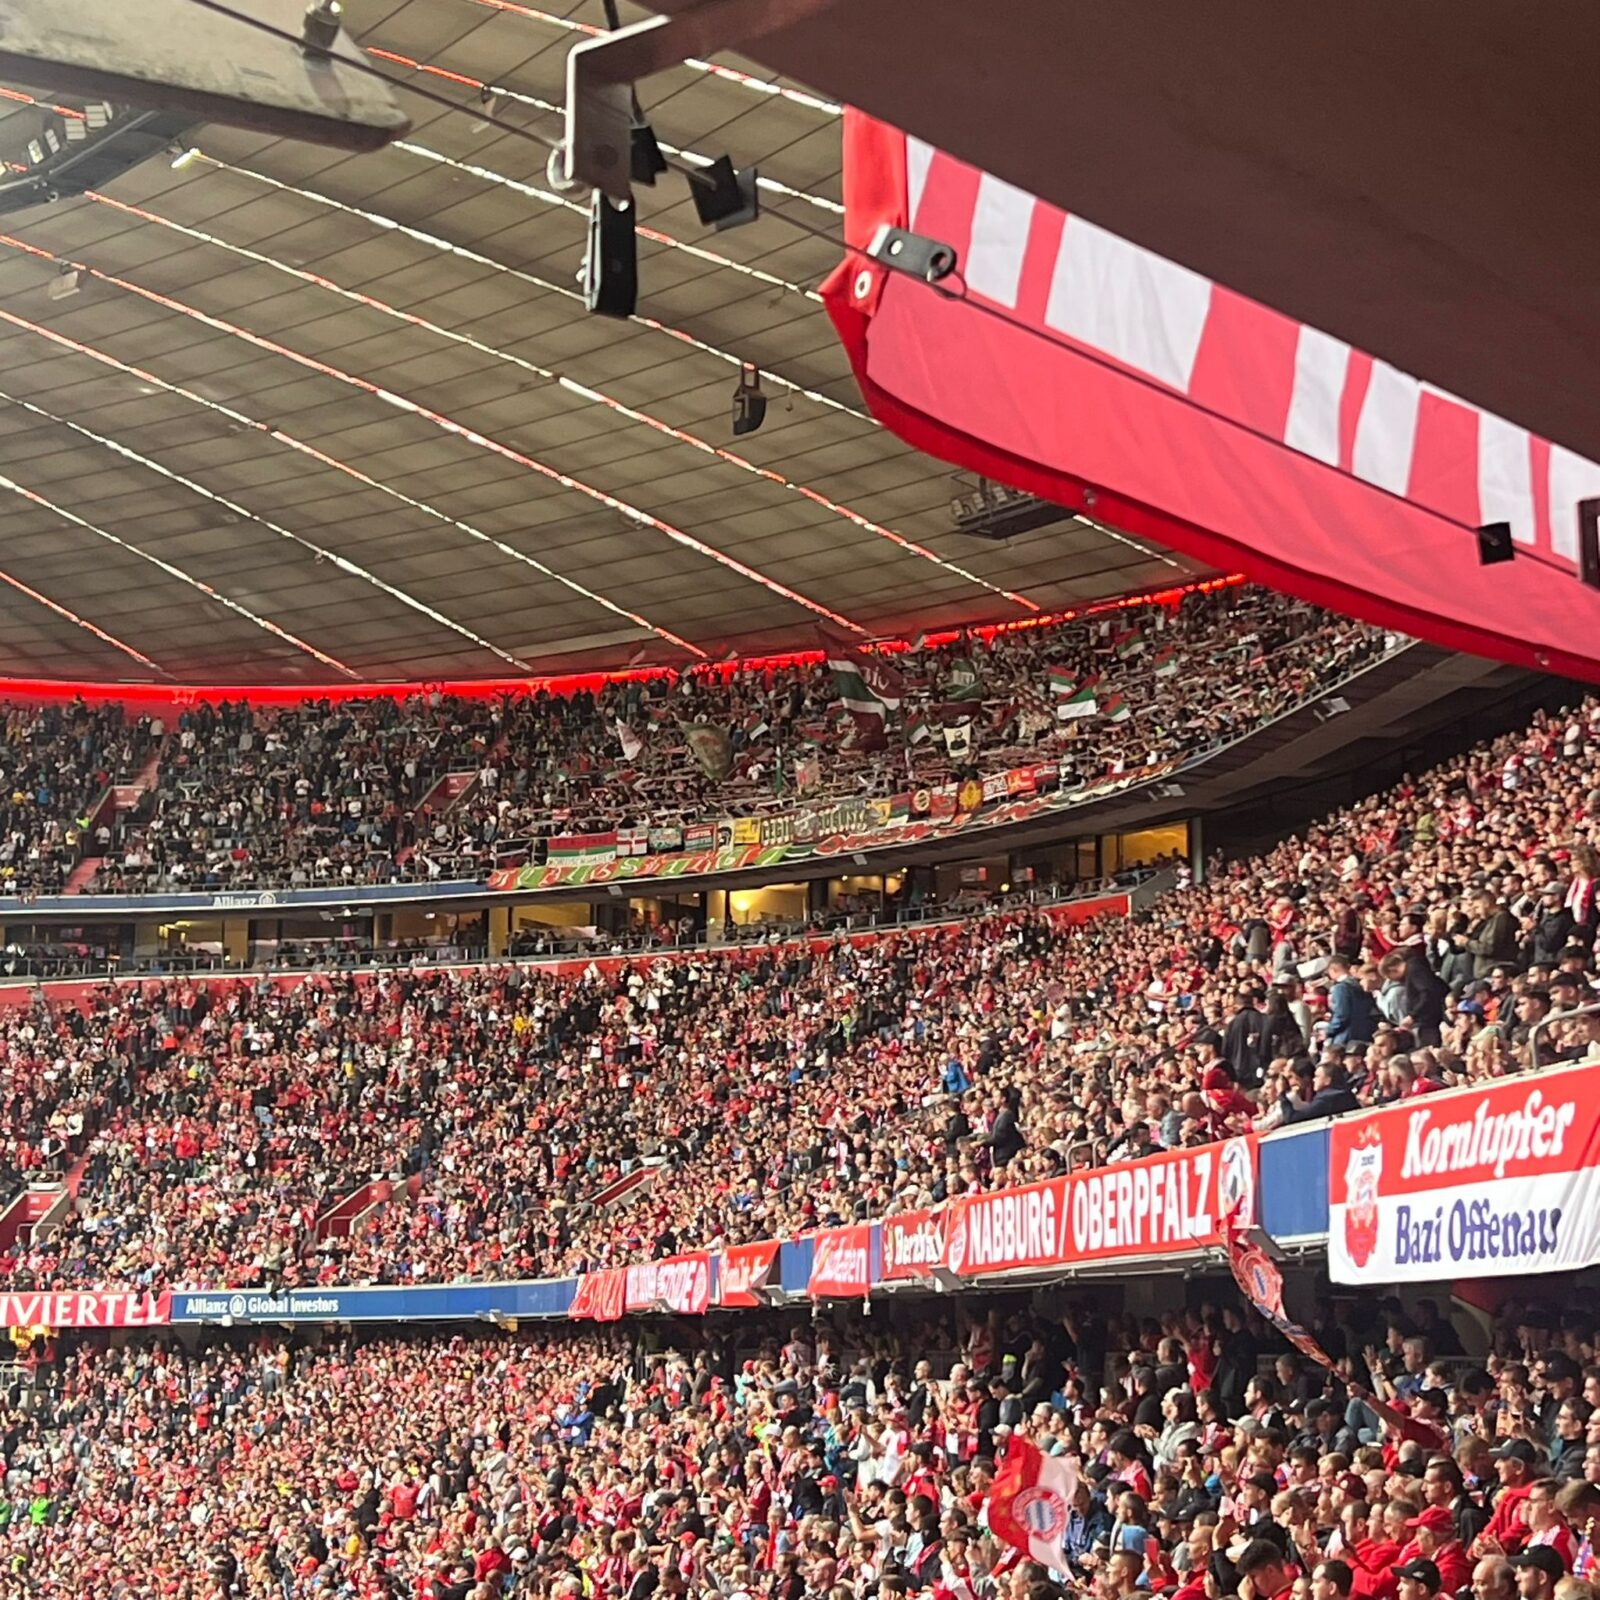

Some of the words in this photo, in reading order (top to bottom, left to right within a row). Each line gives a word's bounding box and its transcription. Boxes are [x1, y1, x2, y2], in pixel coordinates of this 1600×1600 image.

[213, 896, 257, 908] Allianz
[1401, 1089, 1575, 1178] Kornlupfer
[968, 1188, 1055, 1265] NABBURG
[1072, 1153, 1213, 1252] OBERPFALZ
[1395, 1205, 1443, 1264] Bazi
[1450, 1198, 1561, 1261] Offenau
[186, 1298, 227, 1314] Allianz
[248, 1297, 287, 1313] Global
[291, 1297, 338, 1312] Investors
